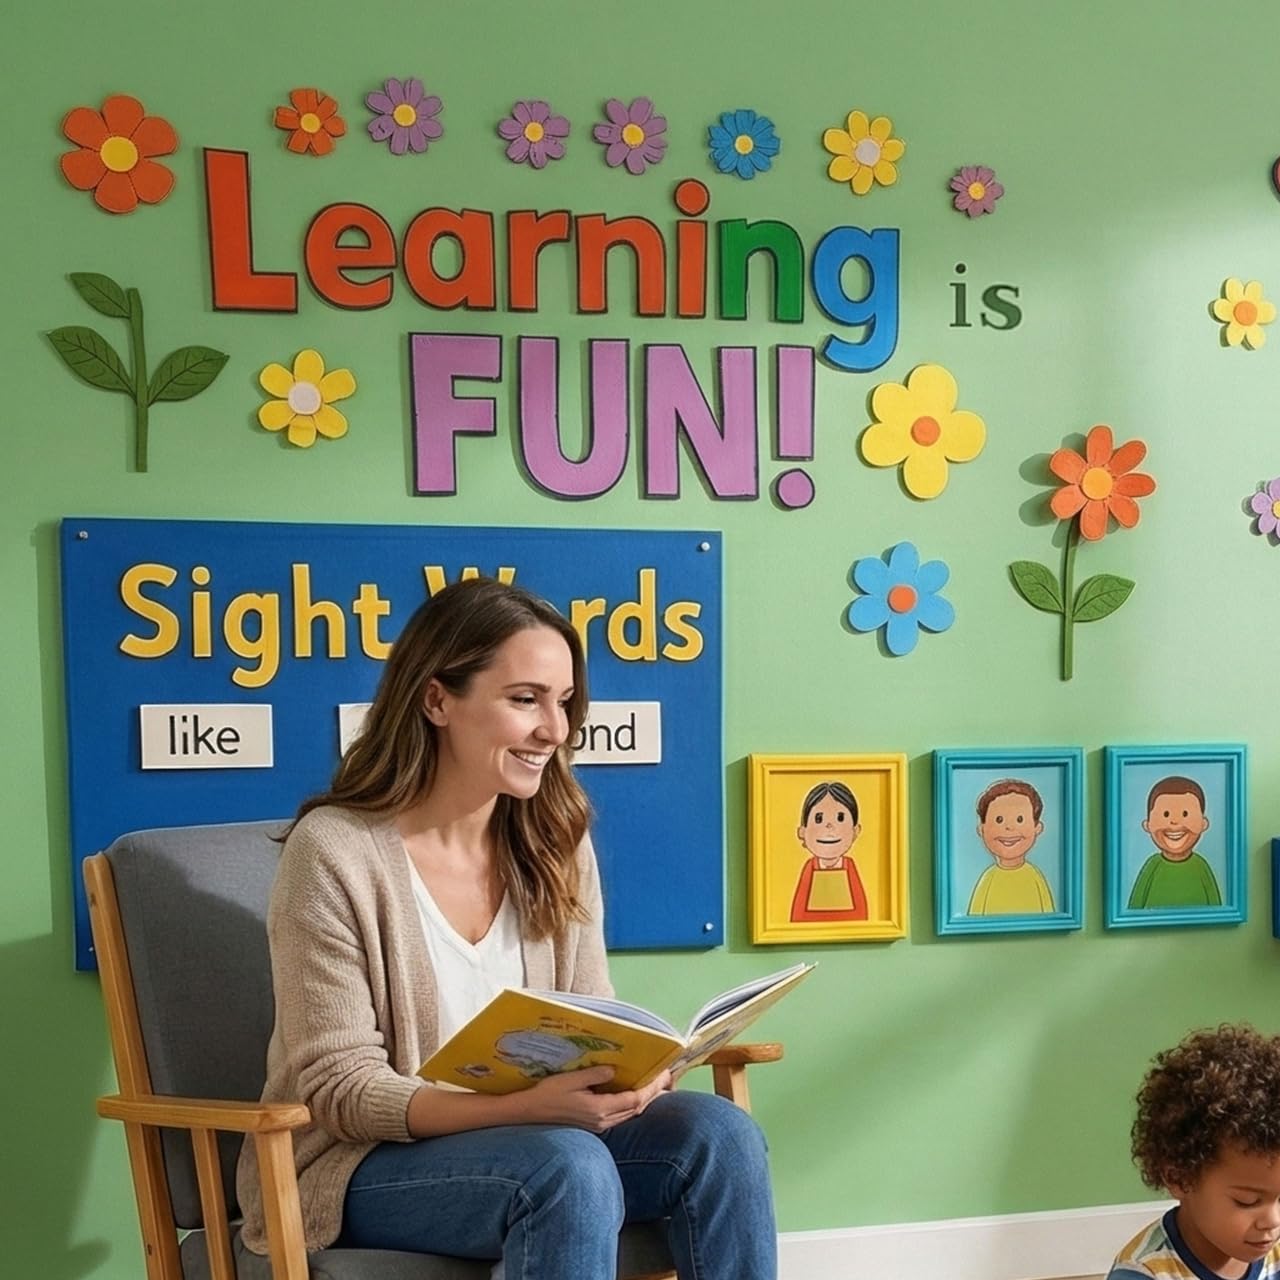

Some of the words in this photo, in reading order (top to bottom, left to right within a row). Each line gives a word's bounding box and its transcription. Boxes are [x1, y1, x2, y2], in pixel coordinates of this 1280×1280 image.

[203, 148, 900, 372] Learning
[948, 263, 1022, 330] is
[408, 332, 816, 510] FUN!
[119, 563, 392, 688] Sight
[424, 565, 704, 661] rds
[169, 714, 240, 757] like
